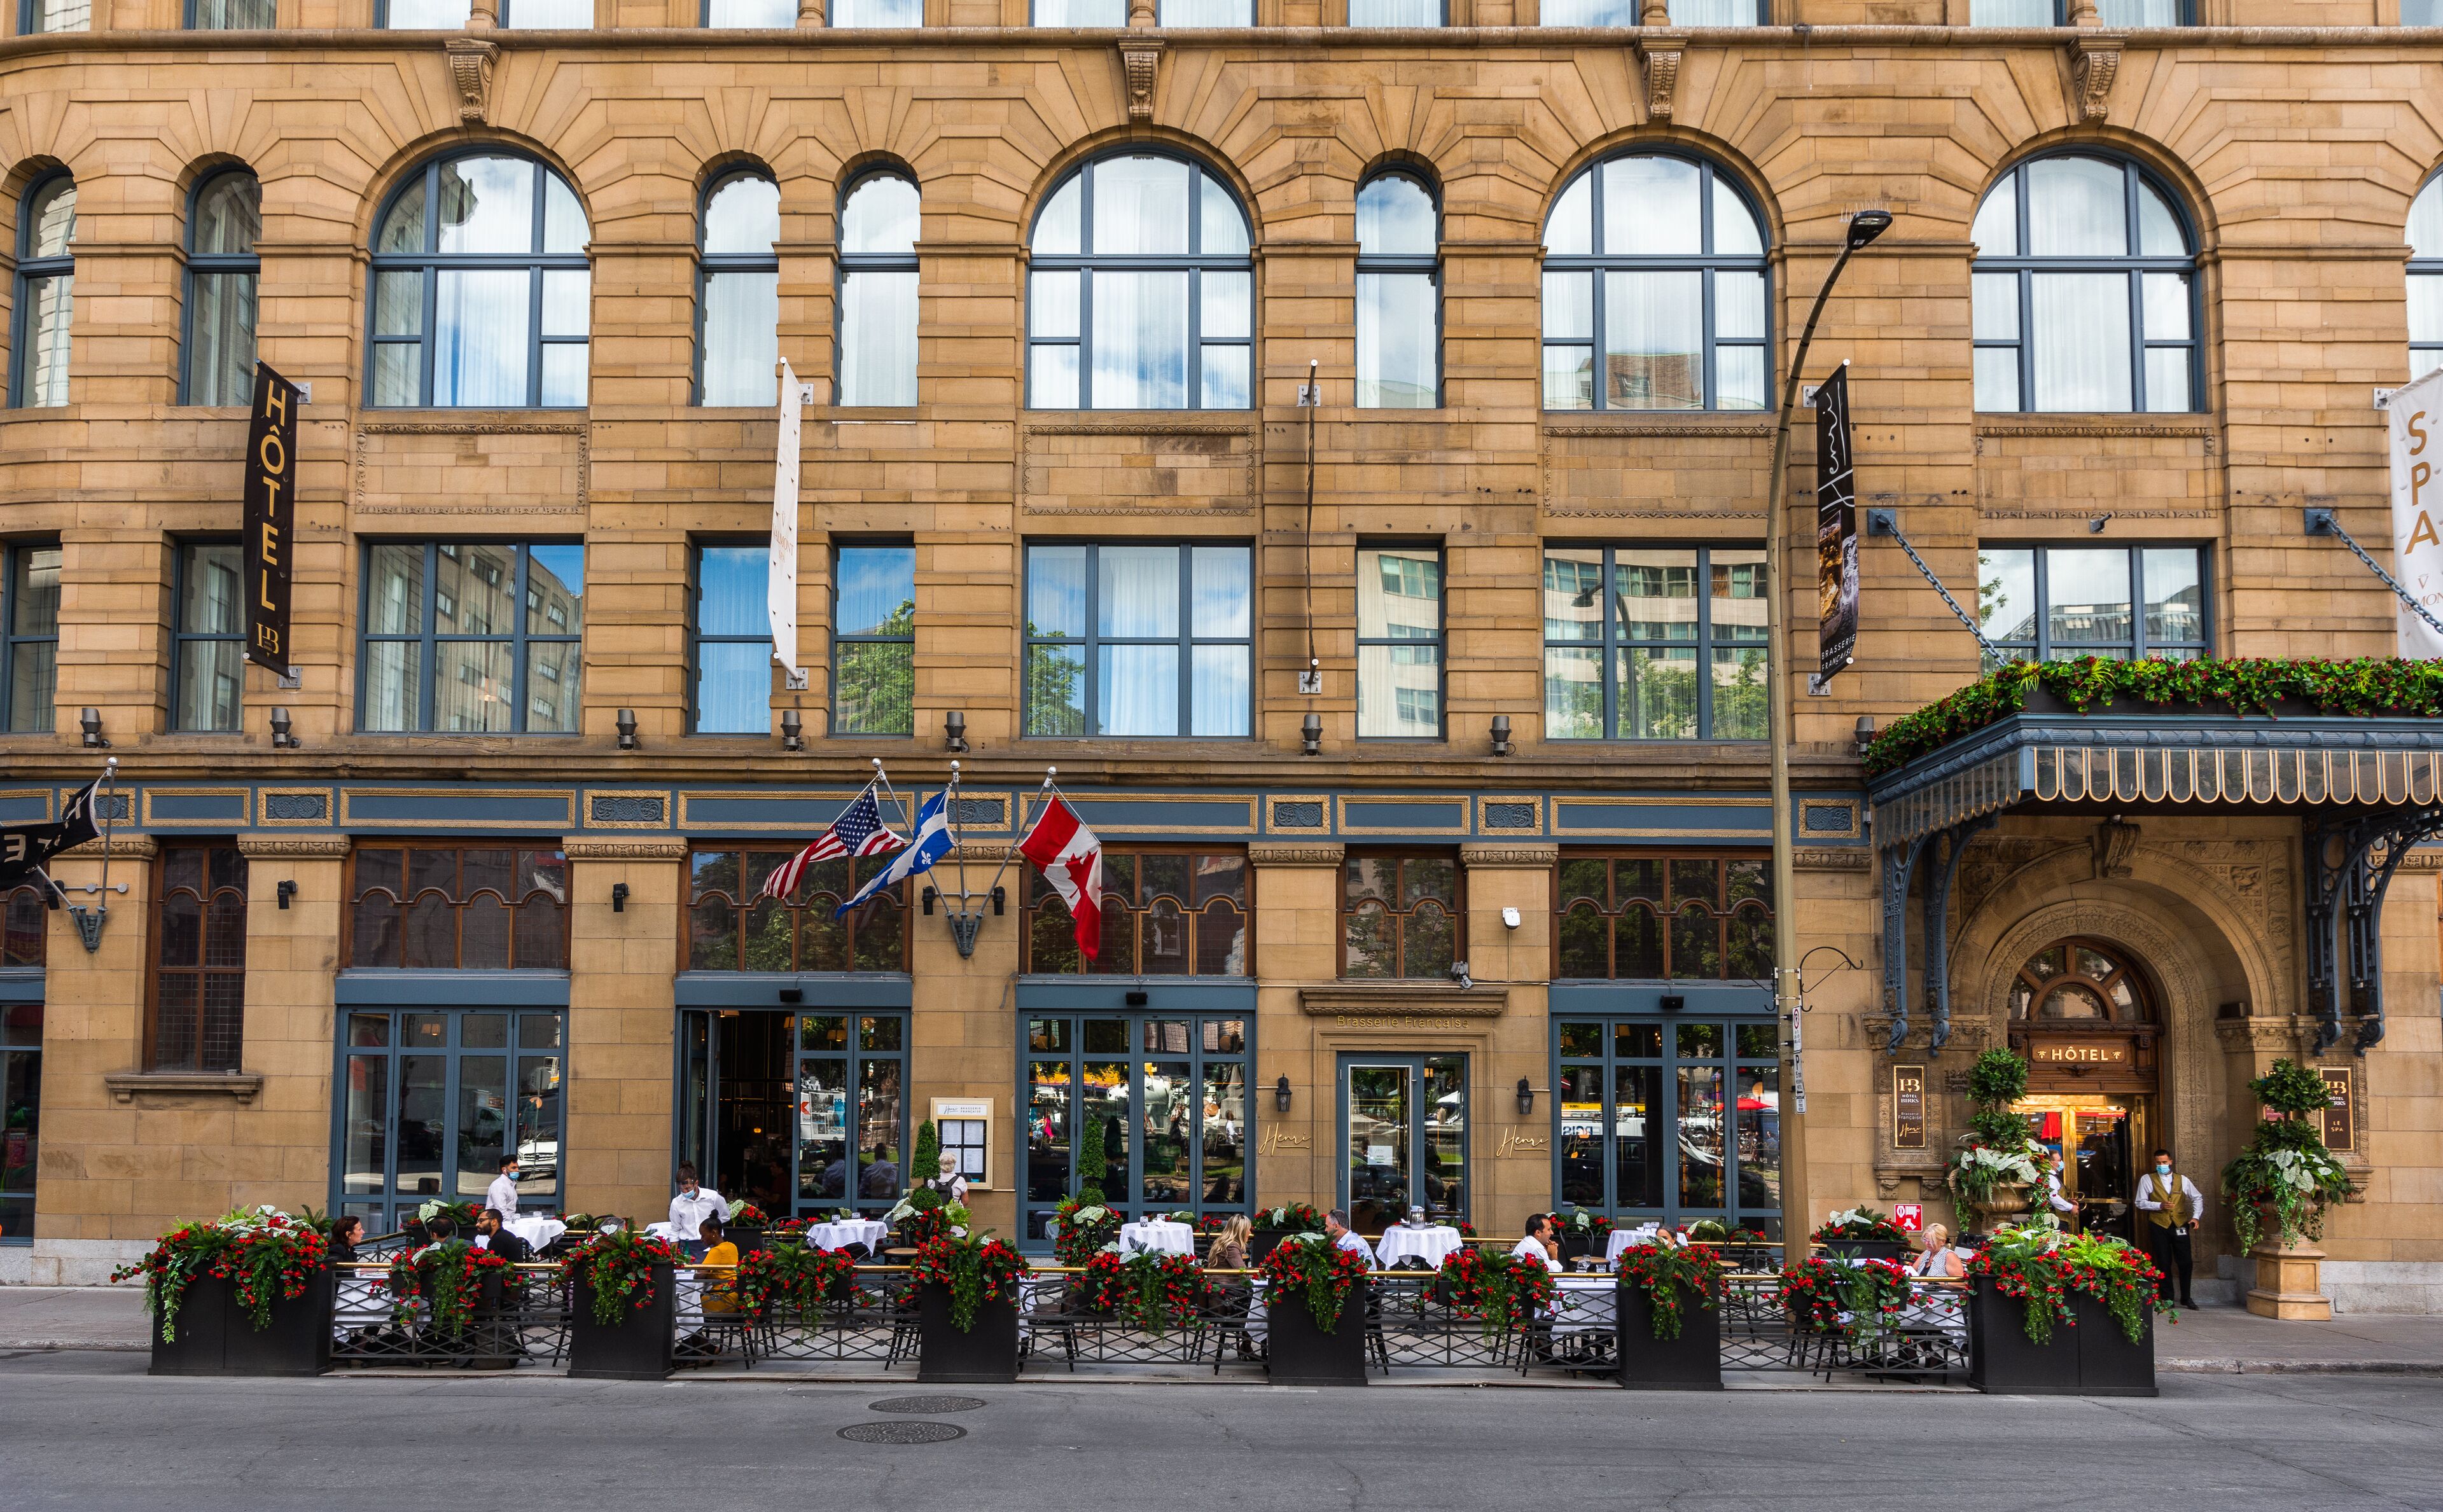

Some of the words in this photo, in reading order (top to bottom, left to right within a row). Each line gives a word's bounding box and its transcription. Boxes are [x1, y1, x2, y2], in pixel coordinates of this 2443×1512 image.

[260, 380, 286, 611] HÔTEL
[2404, 411, 2440, 556] SPA
[1821, 634, 1856, 660] BRASSERIE
[1821, 646, 1853, 672] FRANÇAISE
[1337, 1016, 1398, 1027] Brasserie
[1405, 1016, 1469, 1029] Française
[2051, 1046, 2108, 1061] HÔTEL
[1258, 1122, 1311, 1156] Henri
[1496, 1125, 1549, 1159] Henri
